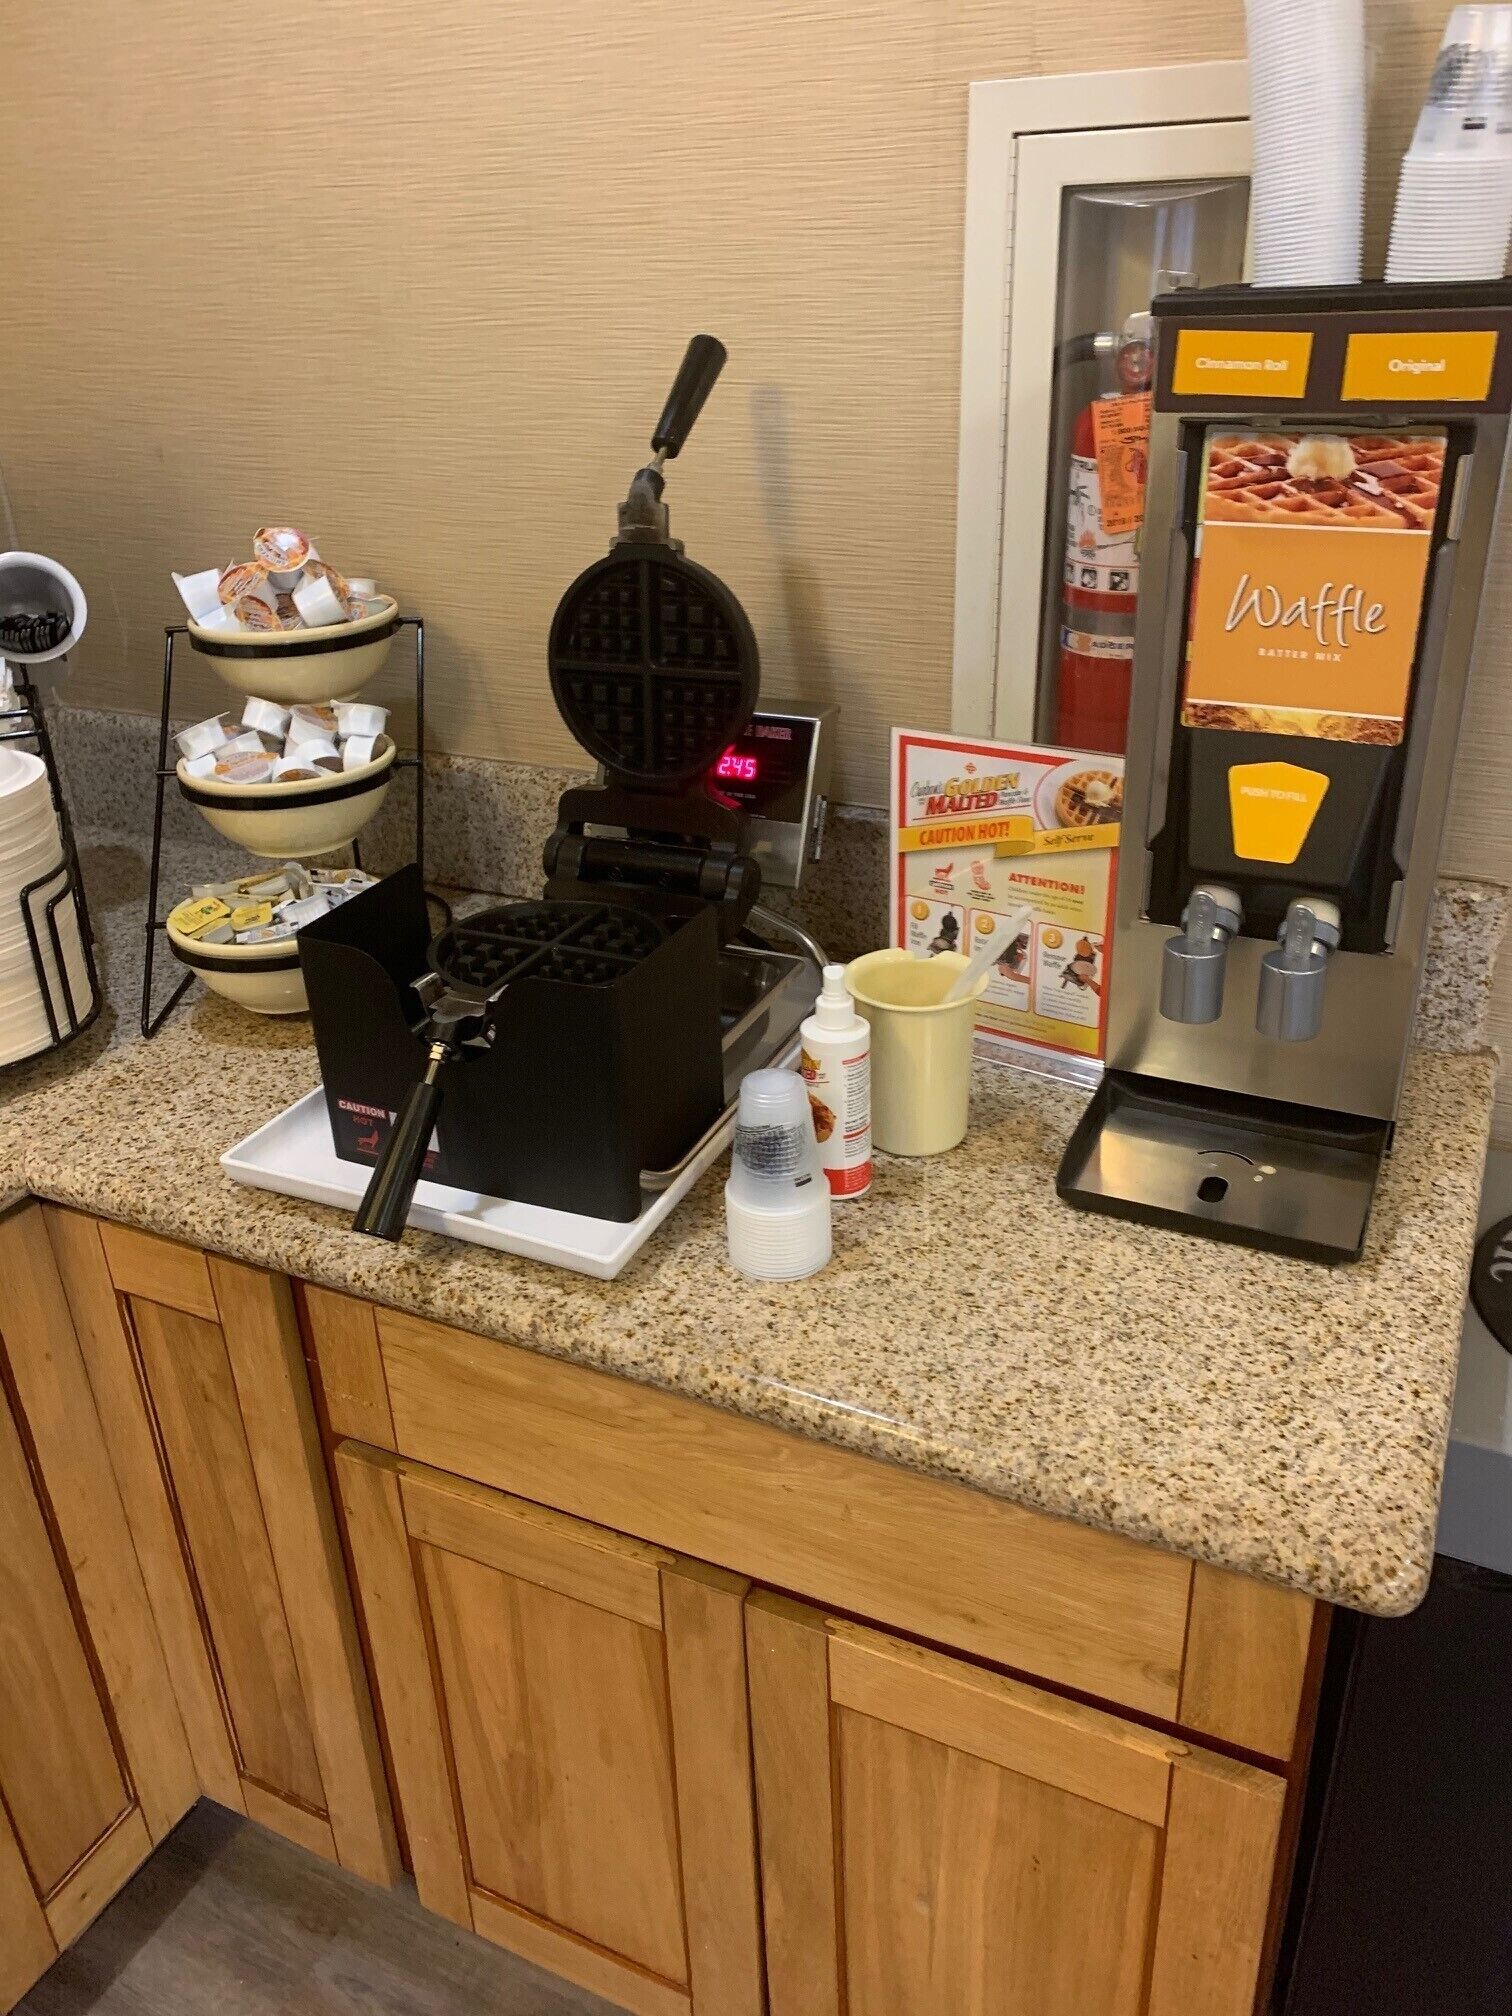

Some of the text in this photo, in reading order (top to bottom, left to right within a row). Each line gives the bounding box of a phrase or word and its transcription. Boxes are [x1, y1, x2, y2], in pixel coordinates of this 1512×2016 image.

[1195, 357, 1289, 371] Cinnamon Roll
[1388, 358, 1446, 375] Original
[1224, 573, 1388, 648] Waffle
[1257, 648, 1343, 662] BATTER MIX
[943, 772, 1020, 797] GOLDEN
[925, 791, 998, 816] MALTED
[920, 821, 1010, 846] CAUTION HOT!
[1008, 872, 1086, 895] ATTENTION!
[338, 1100, 387, 1120] CAUTION
